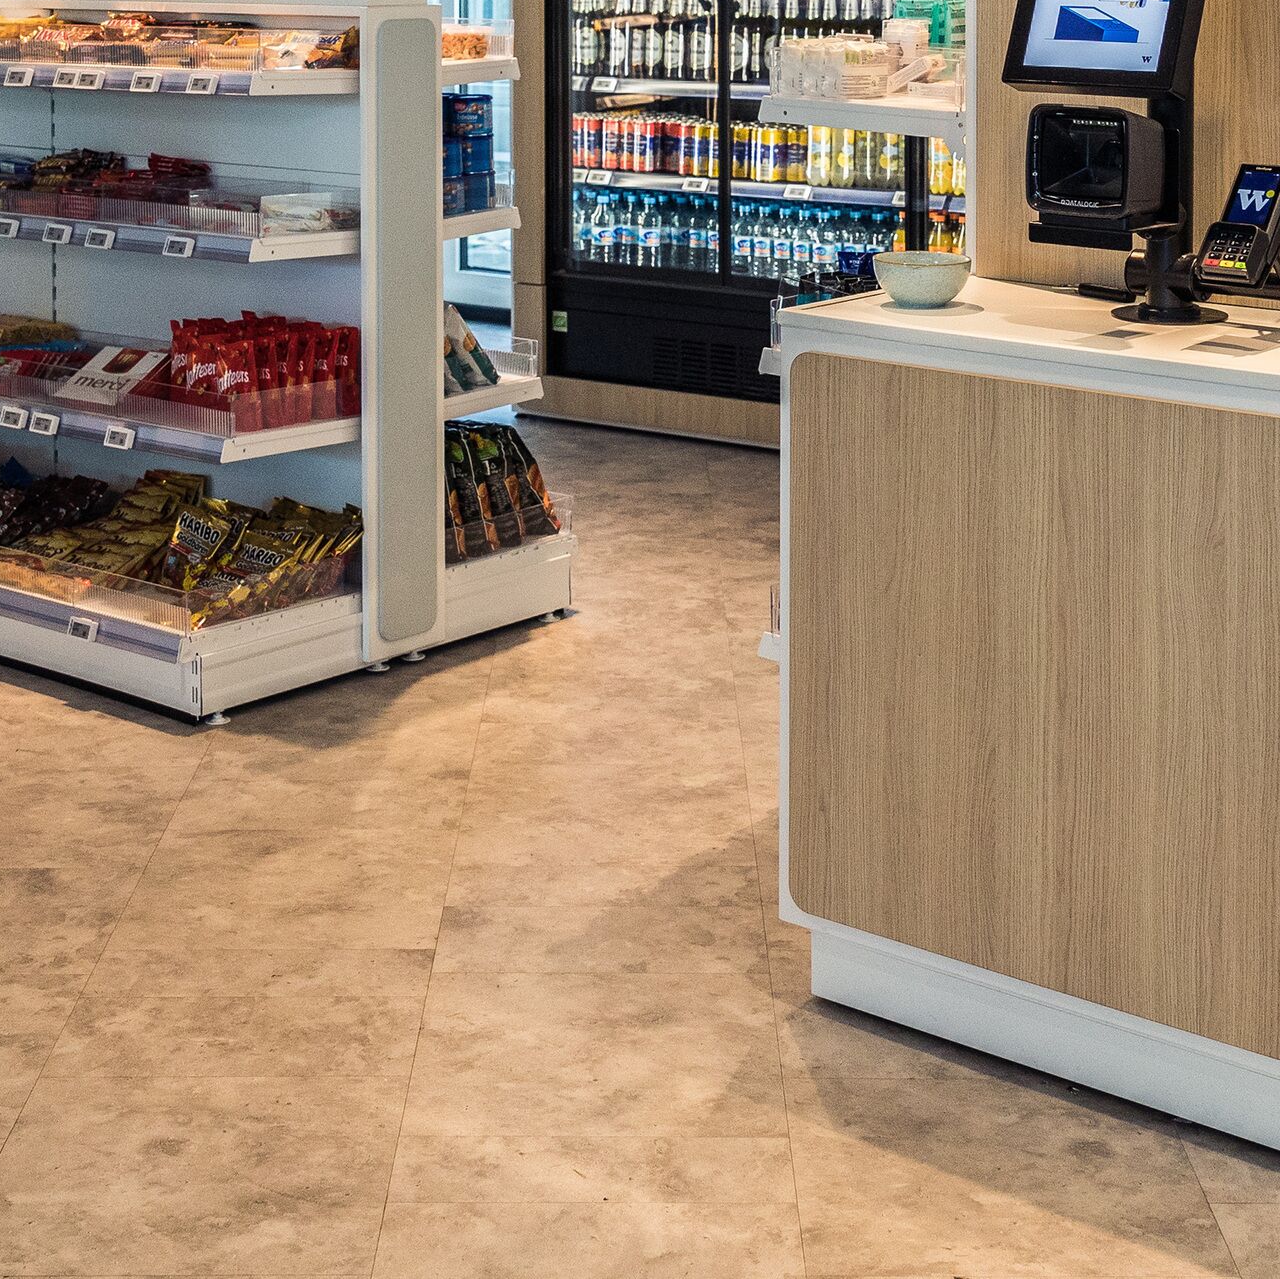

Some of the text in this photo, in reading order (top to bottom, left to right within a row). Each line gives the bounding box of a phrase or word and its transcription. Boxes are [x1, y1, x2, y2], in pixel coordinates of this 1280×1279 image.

[1064, 199, 1100, 208] DATALOGIC
[1237, 188, 1271, 212] W
[179, 511, 221, 545] HARIBO
[240, 543, 285, 568] HARIBO
